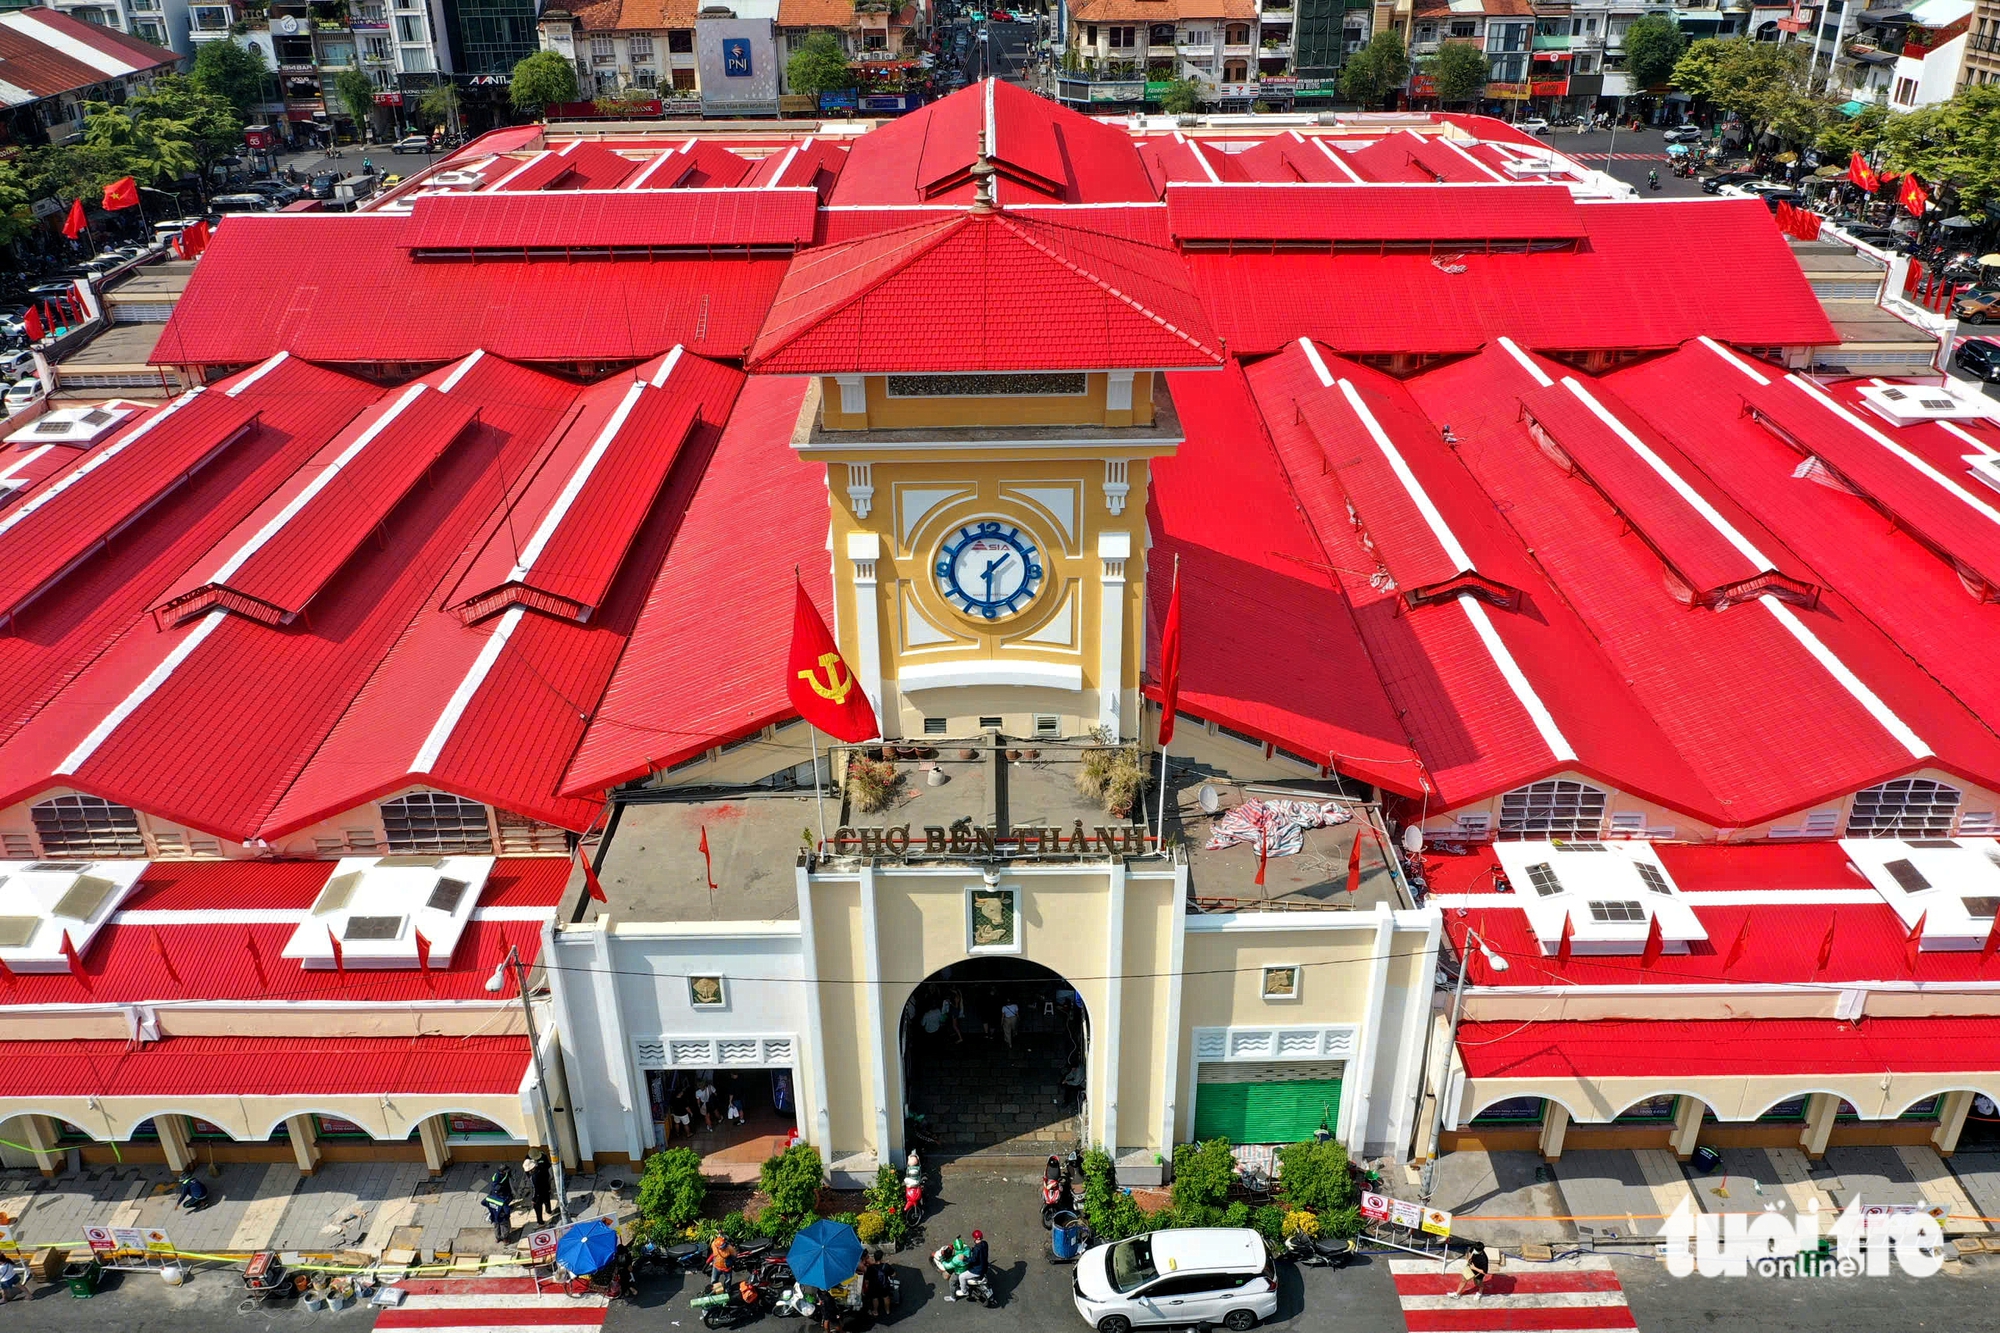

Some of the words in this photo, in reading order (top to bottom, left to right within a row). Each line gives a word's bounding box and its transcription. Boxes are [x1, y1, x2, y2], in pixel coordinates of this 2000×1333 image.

[728, 58, 747, 71] PNJ
[977, 522, 1001, 537] 12
[936, 562, 951, 578] 9
[1028, 564, 1043, 579] 3
[981, 604, 997, 619] 6
[834, 821, 911, 856] CHỢ
[924, 815, 997, 854] BẾN
